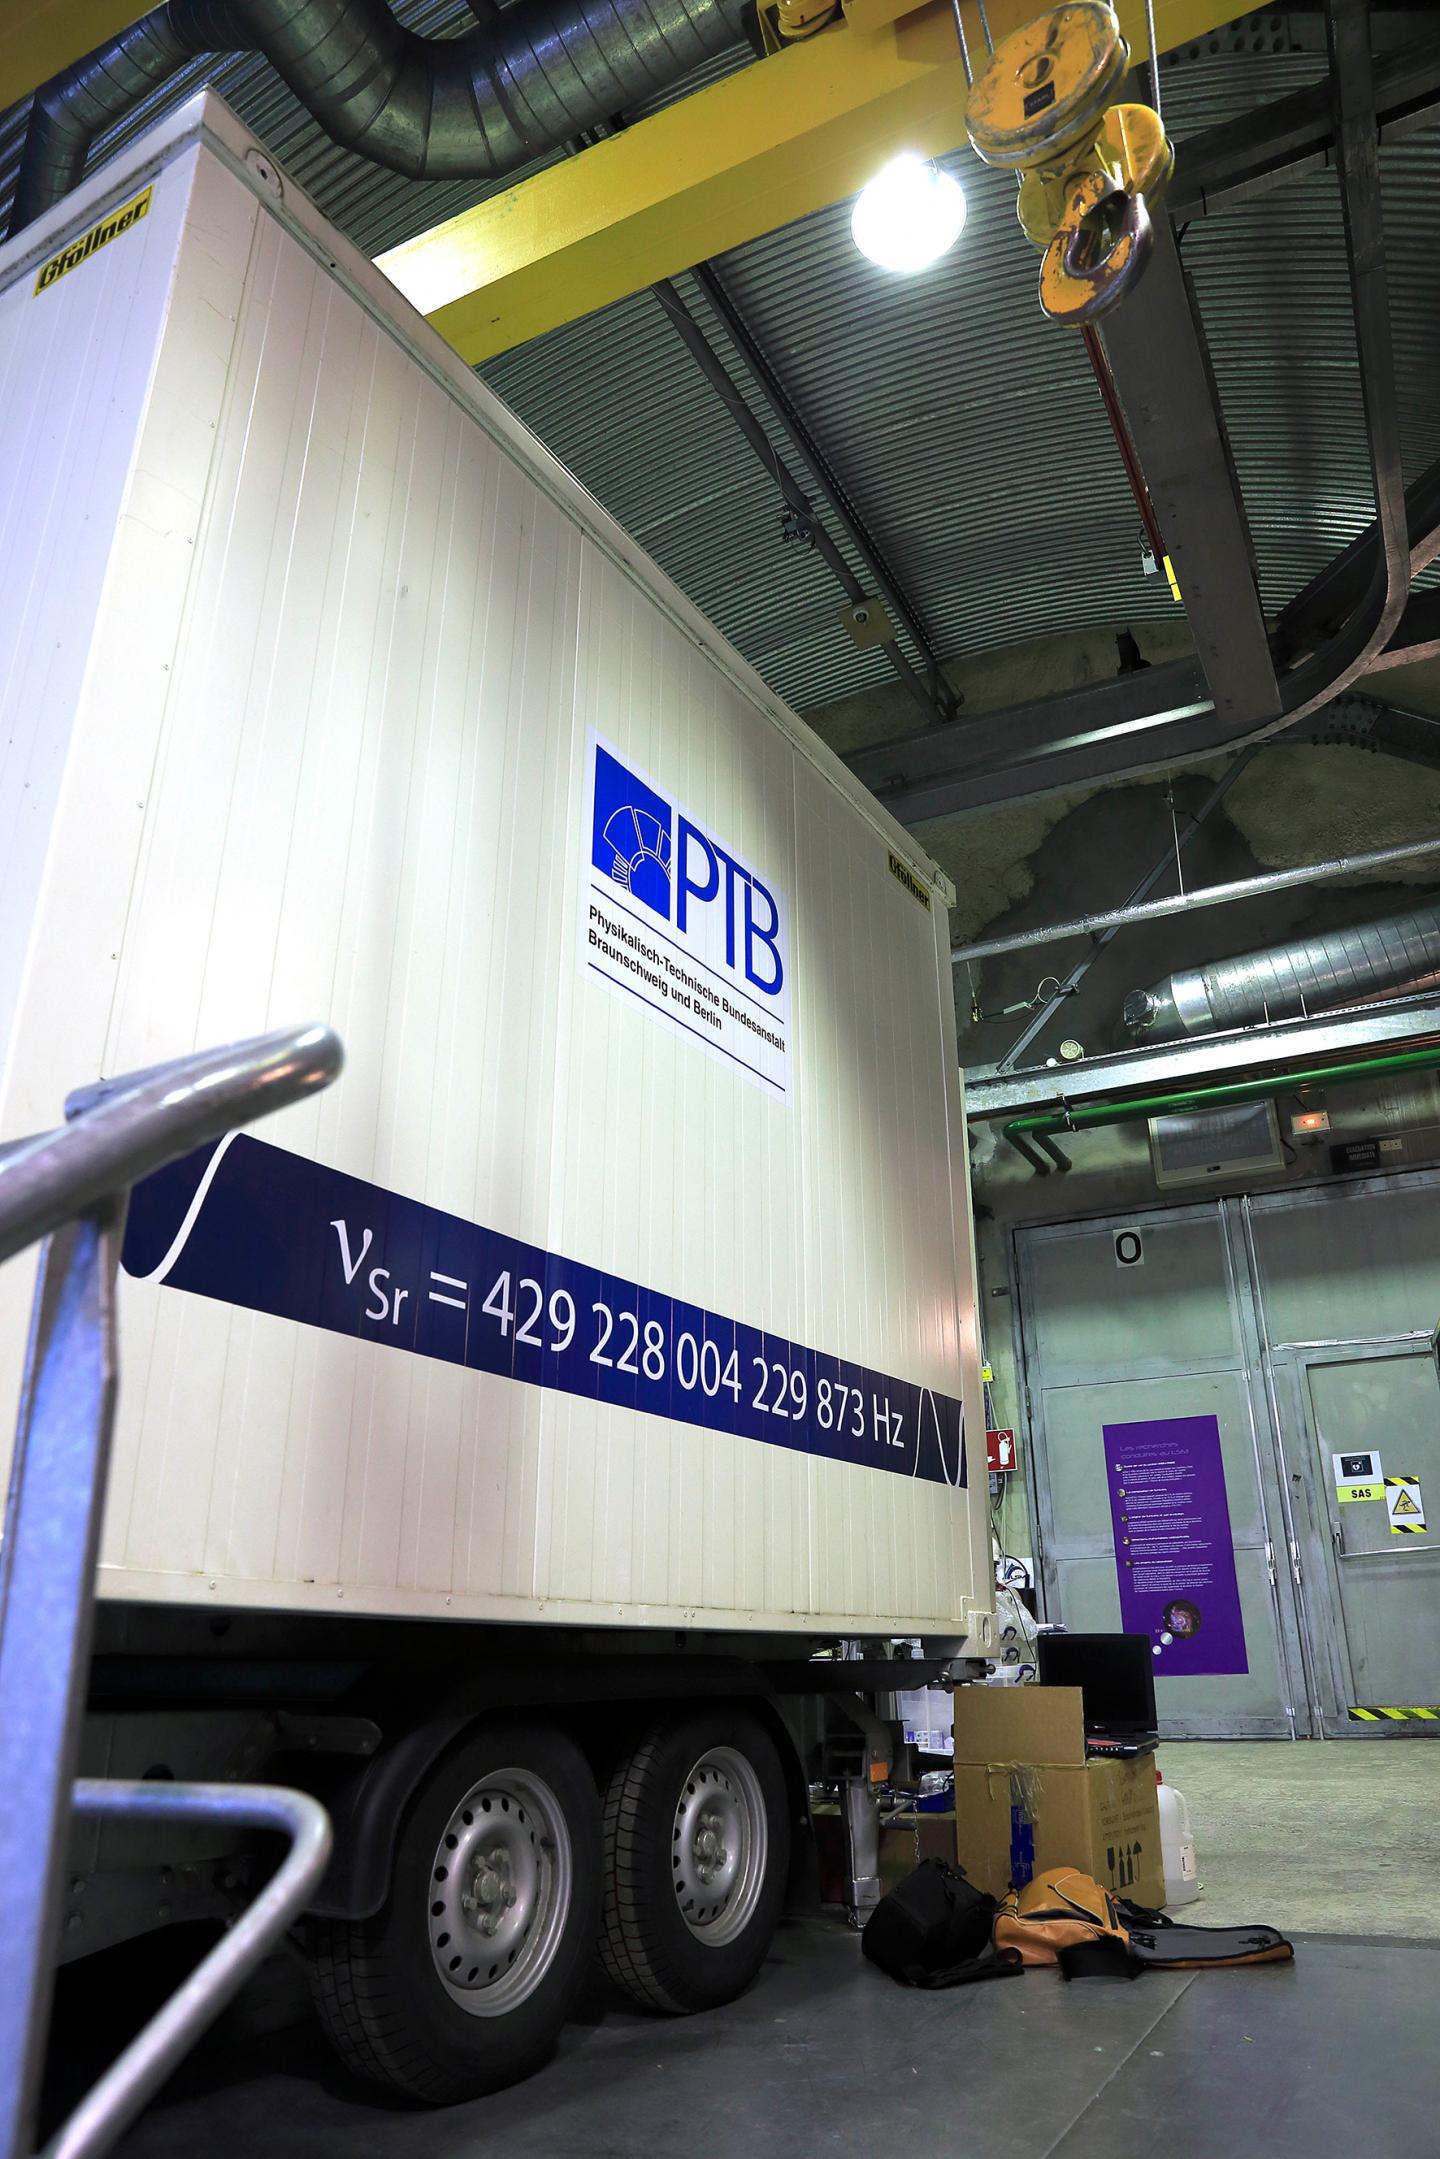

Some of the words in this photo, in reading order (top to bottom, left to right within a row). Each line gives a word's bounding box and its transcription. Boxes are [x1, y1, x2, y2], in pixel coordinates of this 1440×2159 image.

[39, 198, 148, 289] Gföllner
[677, 814, 783, 996] PTB
[588, 928, 669, 997] Braunschweig
[671, 986, 691, 1009] und
[693, 999, 722, 1031] Berlin
[589, 904, 720, 1007] Physikalisch-Technische
[722, 997, 785, 1052] Bundesanstalt
[429, 1271, 467, 1310] =
[482, 1270, 576, 1352] 429
[589, 1302, 665, 1381] 228
[676, 1332, 742, 1404] 004
[752, 1357, 807, 1421] 229
[817, 1378, 865, 1438] 873
[872, 1394, 905, 1448] Hz
[1351, 1488, 1372, 1499] SAS
